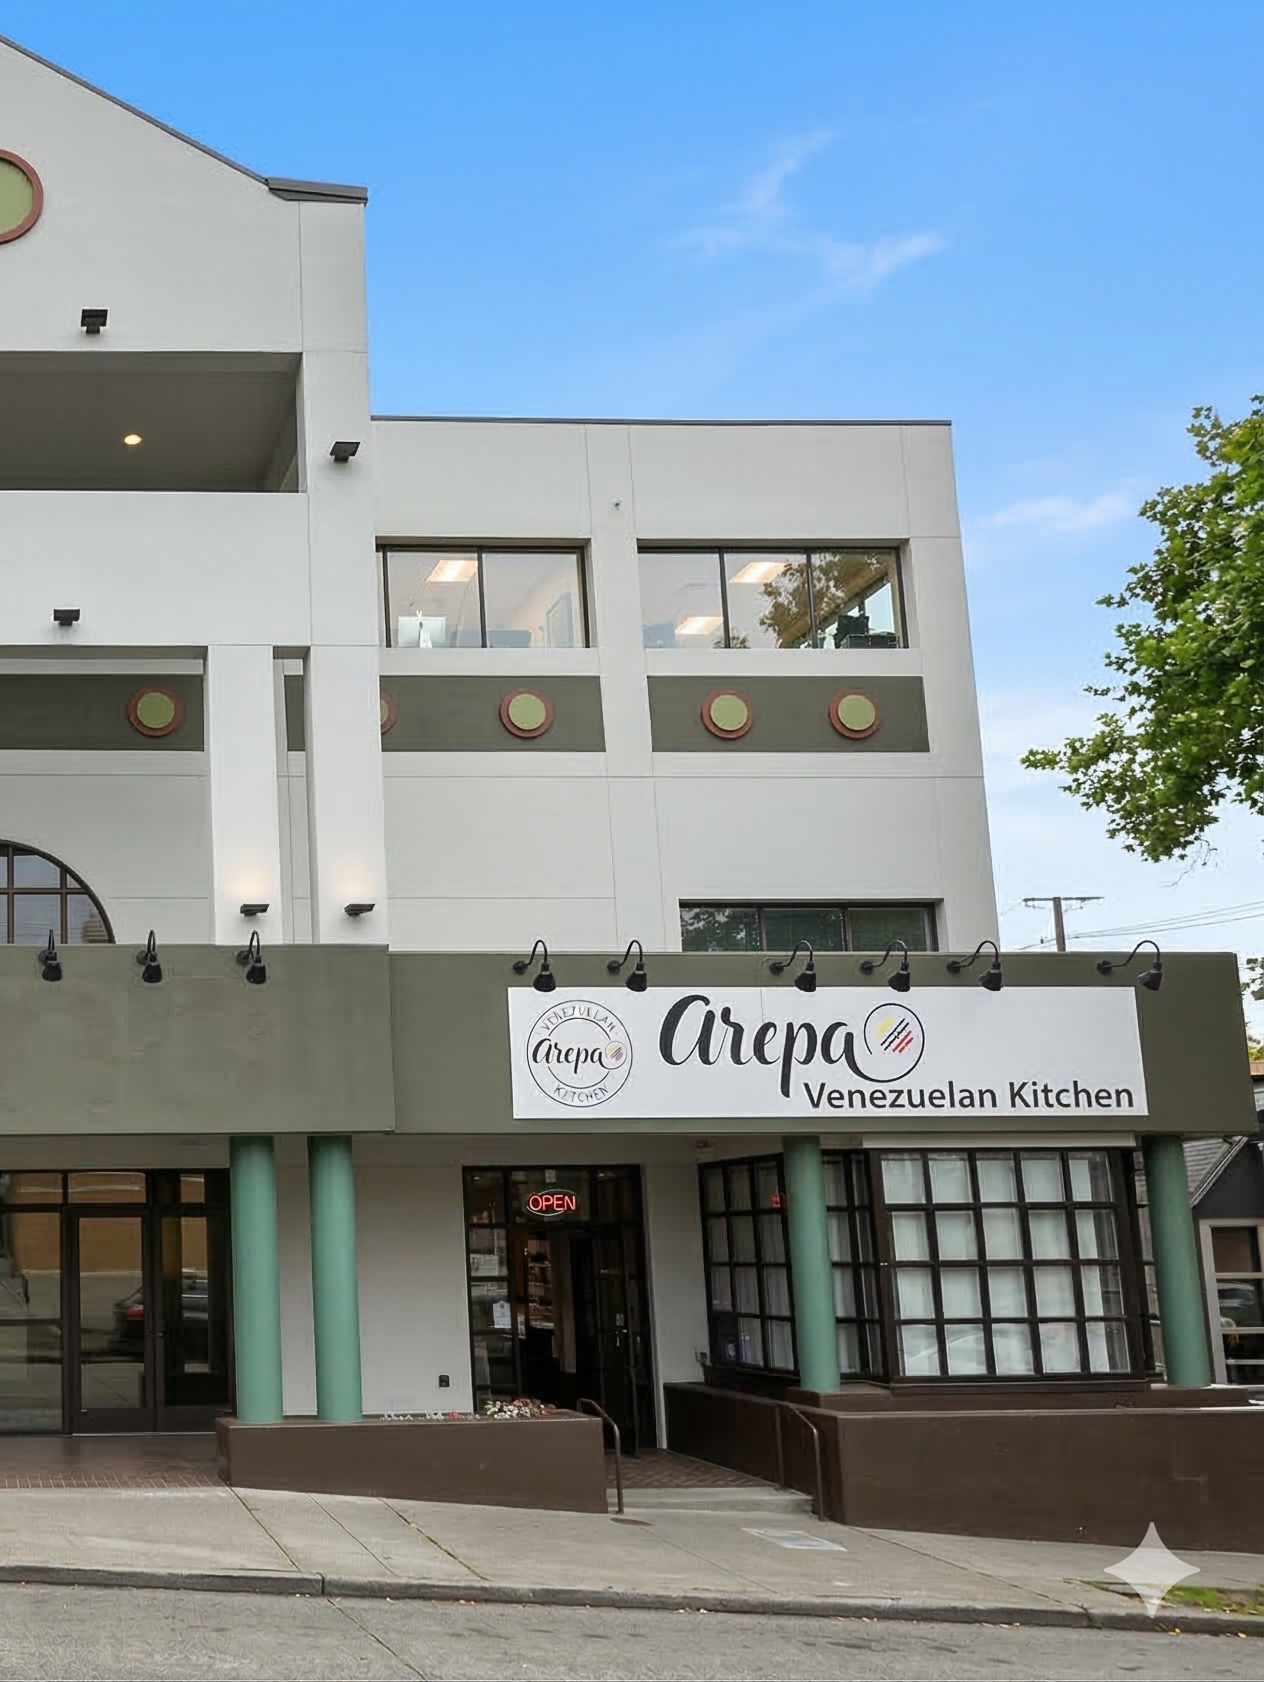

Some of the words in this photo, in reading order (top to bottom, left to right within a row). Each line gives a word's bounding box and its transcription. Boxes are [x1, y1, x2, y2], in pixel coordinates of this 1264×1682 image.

[803, 1080, 998, 1109] Venezuelan
[1008, 1080, 1135, 1109] Kitchen
[529, 1194, 577, 1211] OPEN
